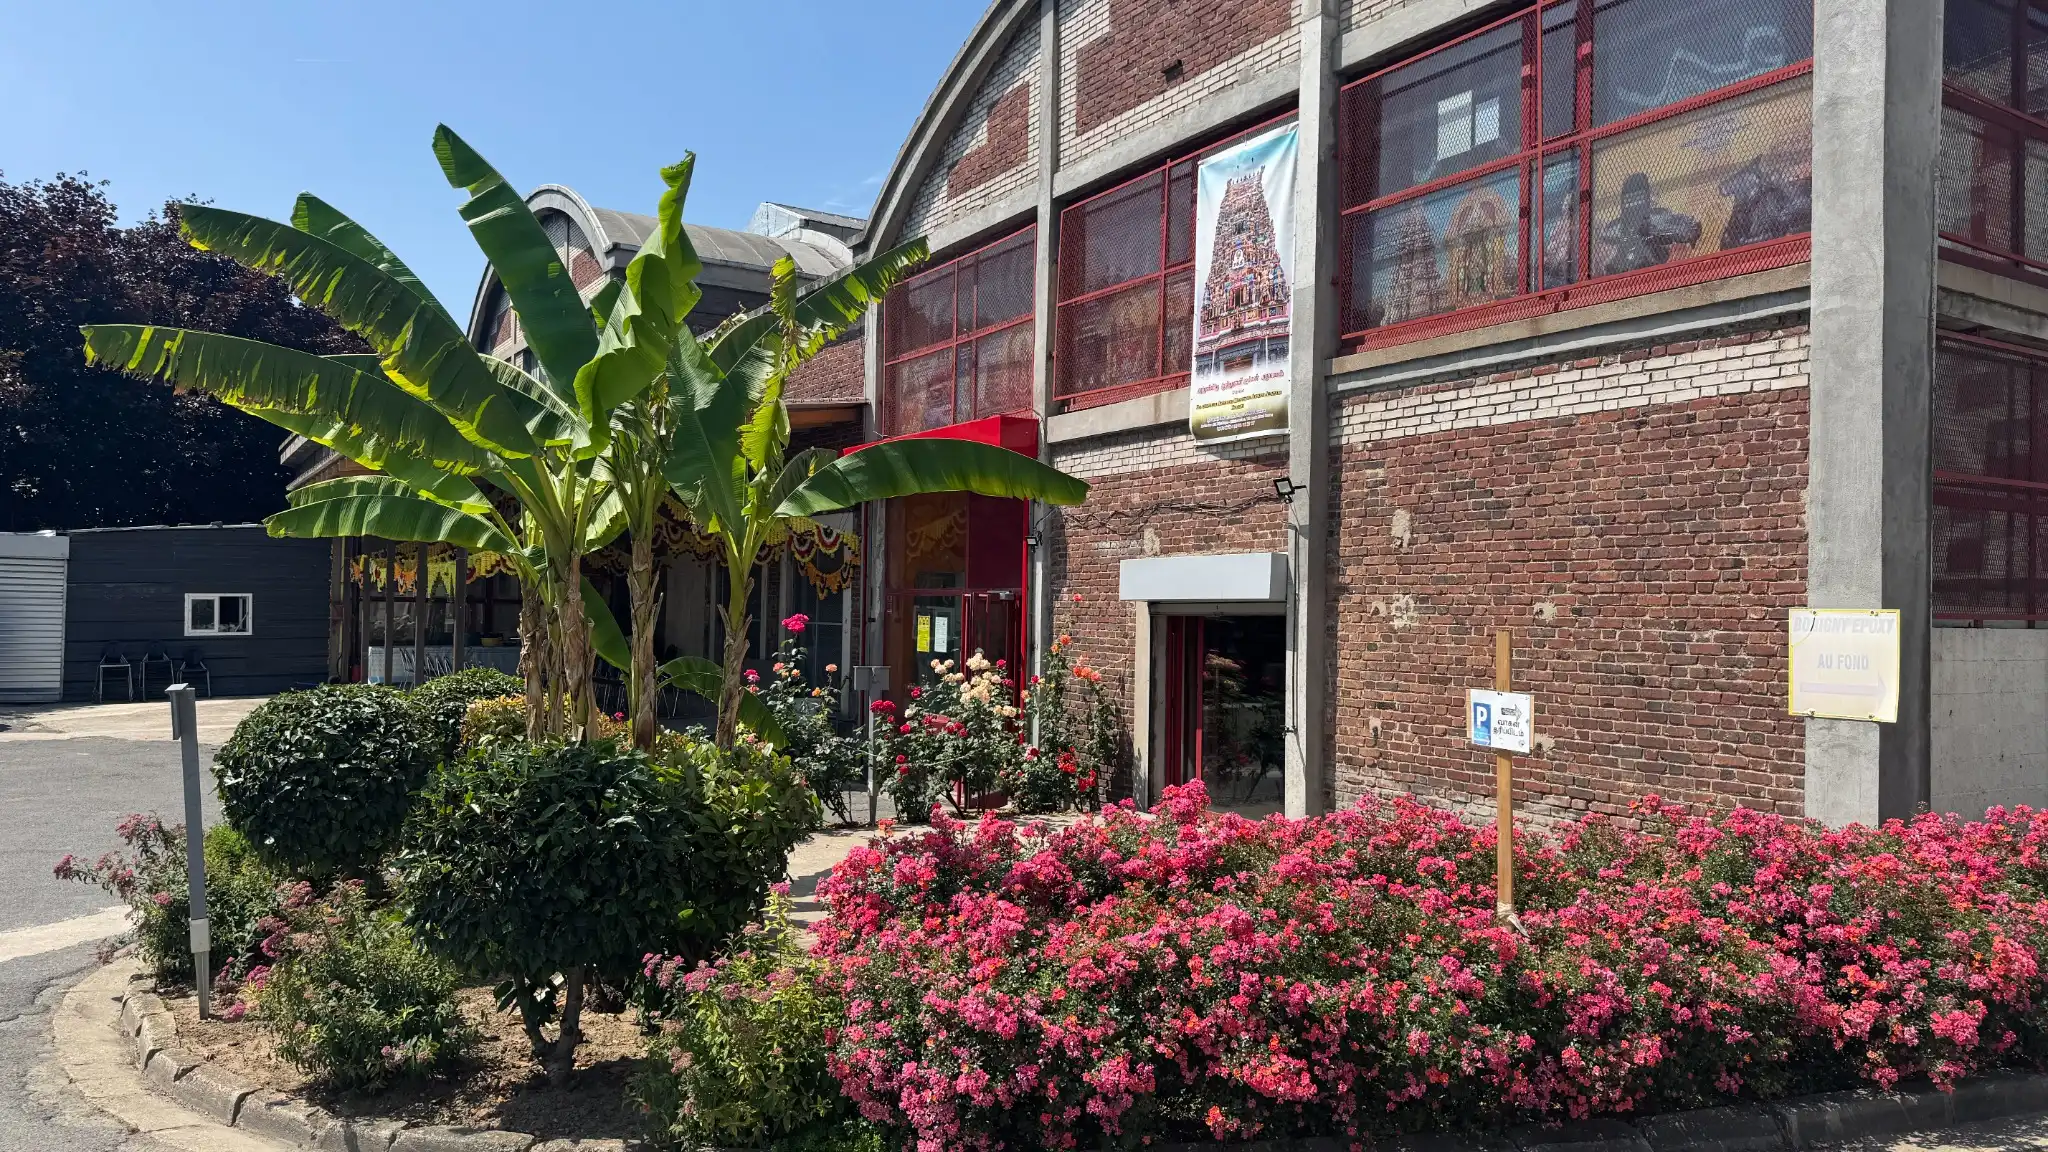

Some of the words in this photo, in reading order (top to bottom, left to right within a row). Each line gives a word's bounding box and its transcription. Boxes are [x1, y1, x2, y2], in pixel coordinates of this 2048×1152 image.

[1817, 653, 1833, 669] AU
[1838, 654, 1869, 670] FOND
[1476, 705, 1487, 728] P
